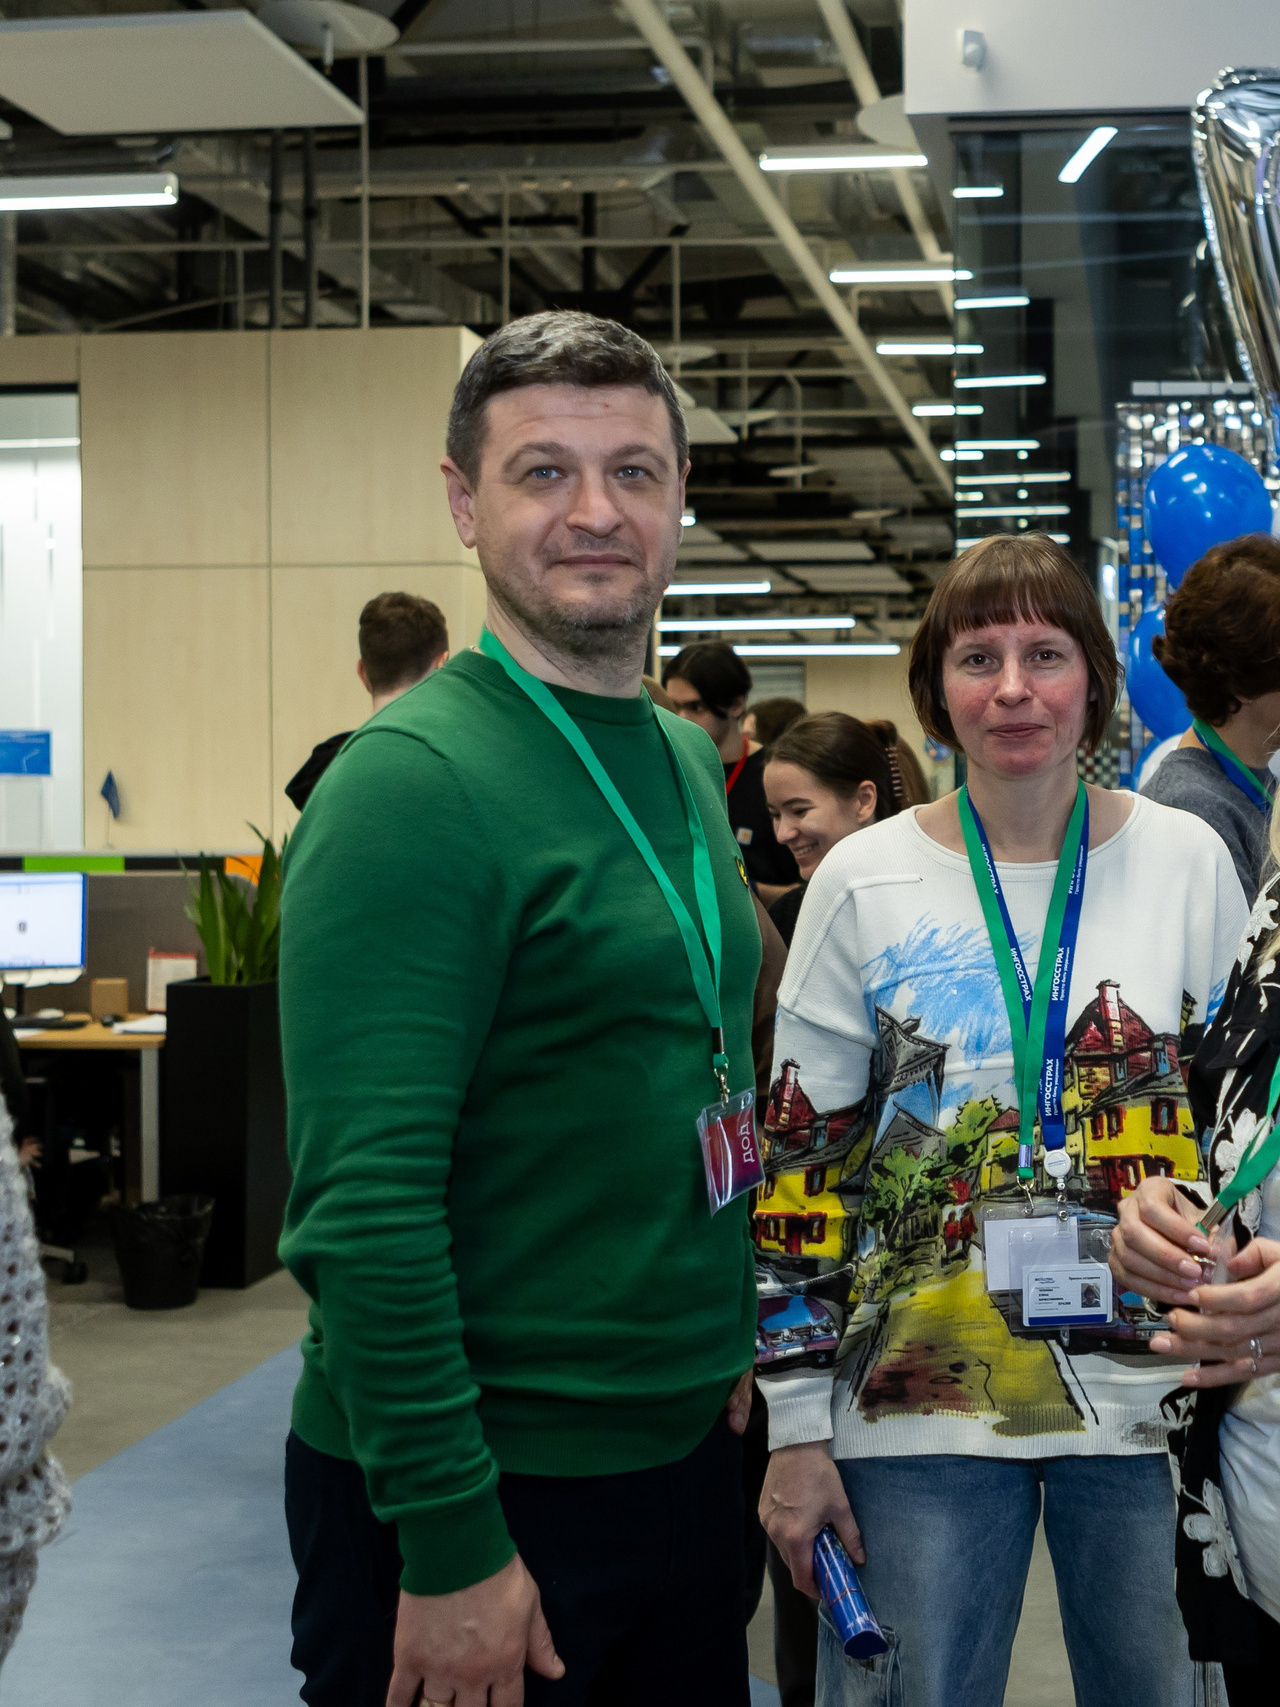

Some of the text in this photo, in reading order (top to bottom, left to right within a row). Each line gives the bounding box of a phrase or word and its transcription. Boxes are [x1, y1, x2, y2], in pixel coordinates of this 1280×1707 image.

[1010, 947, 1032, 1002] ИНГОССТРАХ
[1051, 946, 1065, 1001] ИНГОССТРАХ
[1044, 1058, 1054, 1117] ИНГОССТРАХ
[740, 1121, 755, 1163] ДОД
